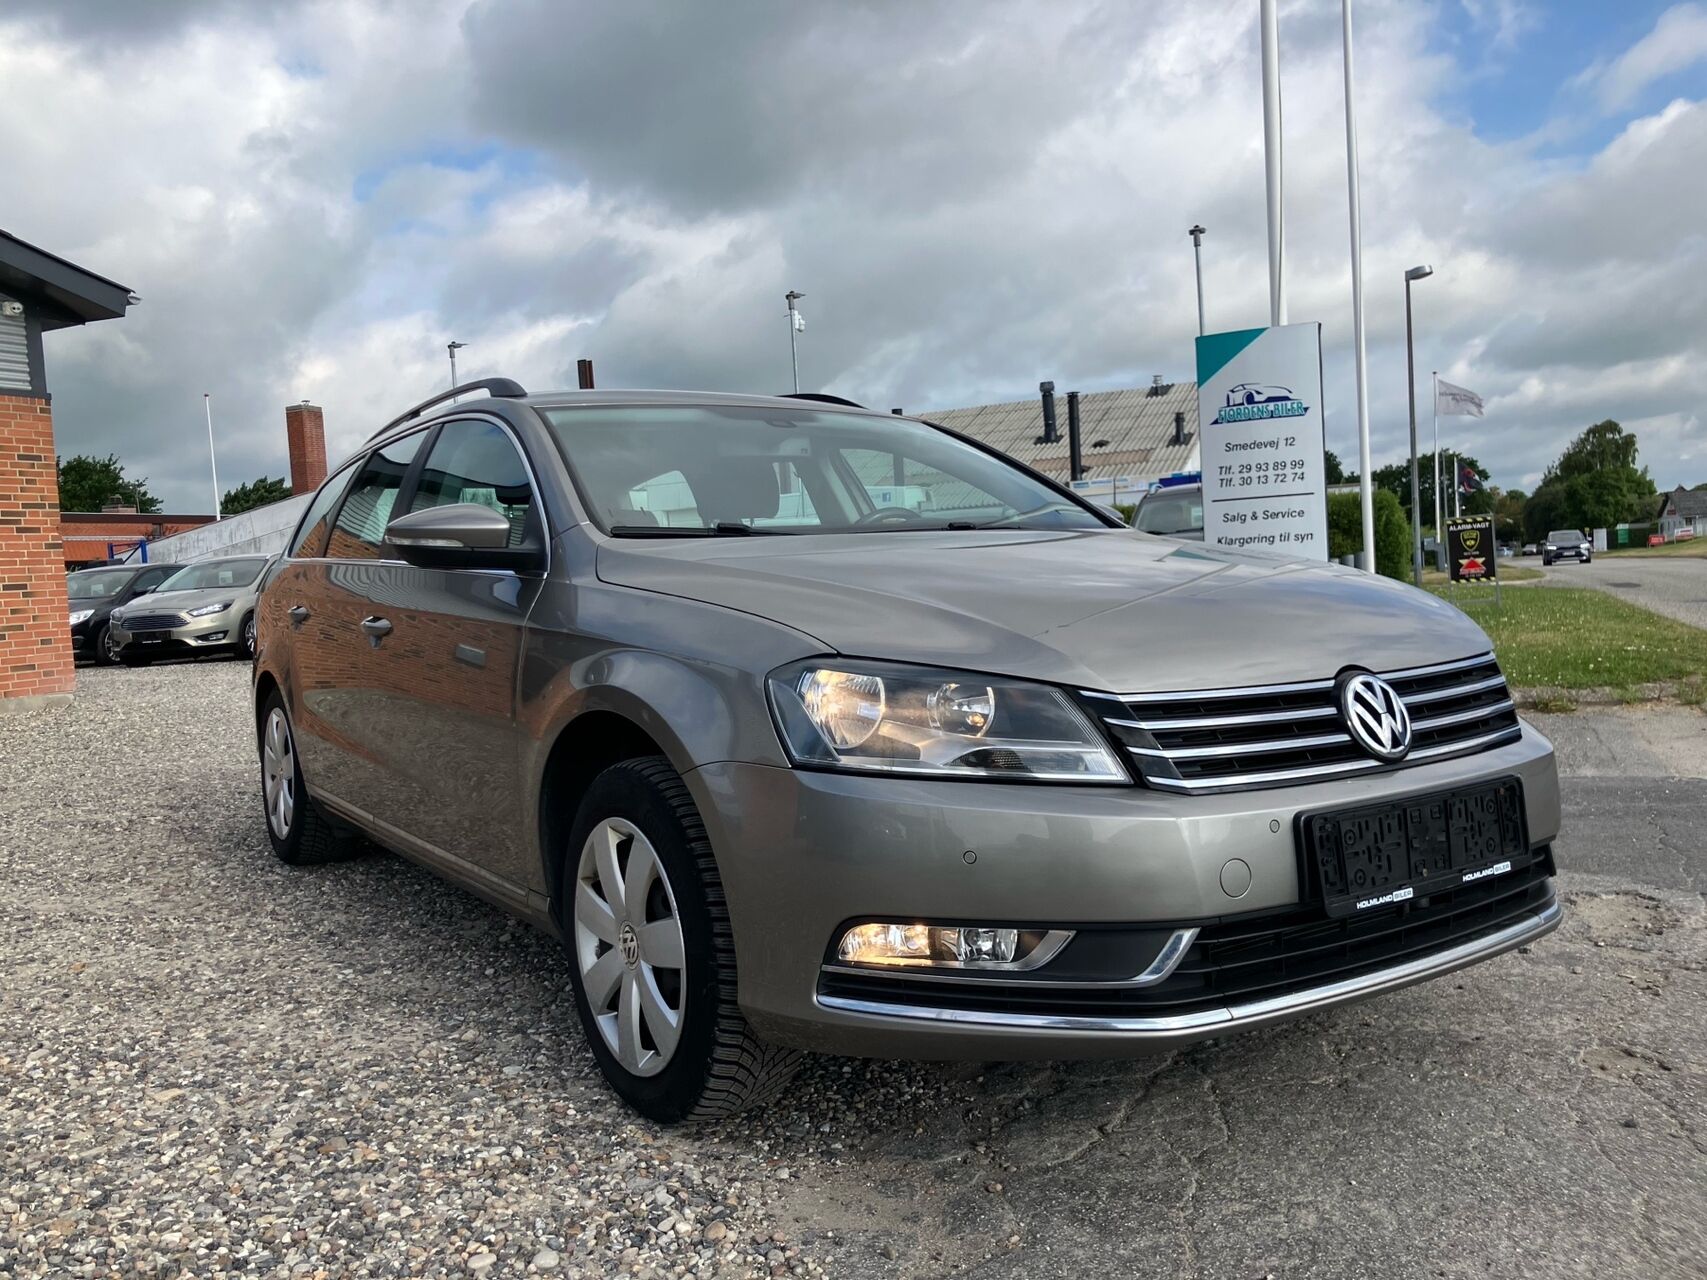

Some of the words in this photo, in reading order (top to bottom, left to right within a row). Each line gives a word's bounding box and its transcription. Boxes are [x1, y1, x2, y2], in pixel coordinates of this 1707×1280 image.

[1224, 438, 1280, 453] Smedevej
[1284, 436, 1296, 447] 12
[1217, 465, 1235, 476] Tlf.
[1238, 464, 1252, 474] 29
[1255, 462, 1269, 472] 93
[1272, 461, 1287, 471] 89
[1290, 459, 1305, 469] 99
[1218, 477, 1236, 488] Tlf.
[1238, 476, 1253, 486] 30
[1257, 475, 1269, 485] 13
[1273, 473, 1287, 483] 72
[1291, 472, 1305, 482] 74
[1222, 512, 1247, 524] Salg
[1250, 511, 1258, 521] &
[1262, 508, 1305, 521] Service
[1279, 532, 1290, 542] til
[1293, 532, 1314, 543] syn
[1462, 868, 1494, 882] HOLMLAND
[1495, 862, 1511, 873] BILER
[1356, 895, 1393, 909] HOLMLAND
